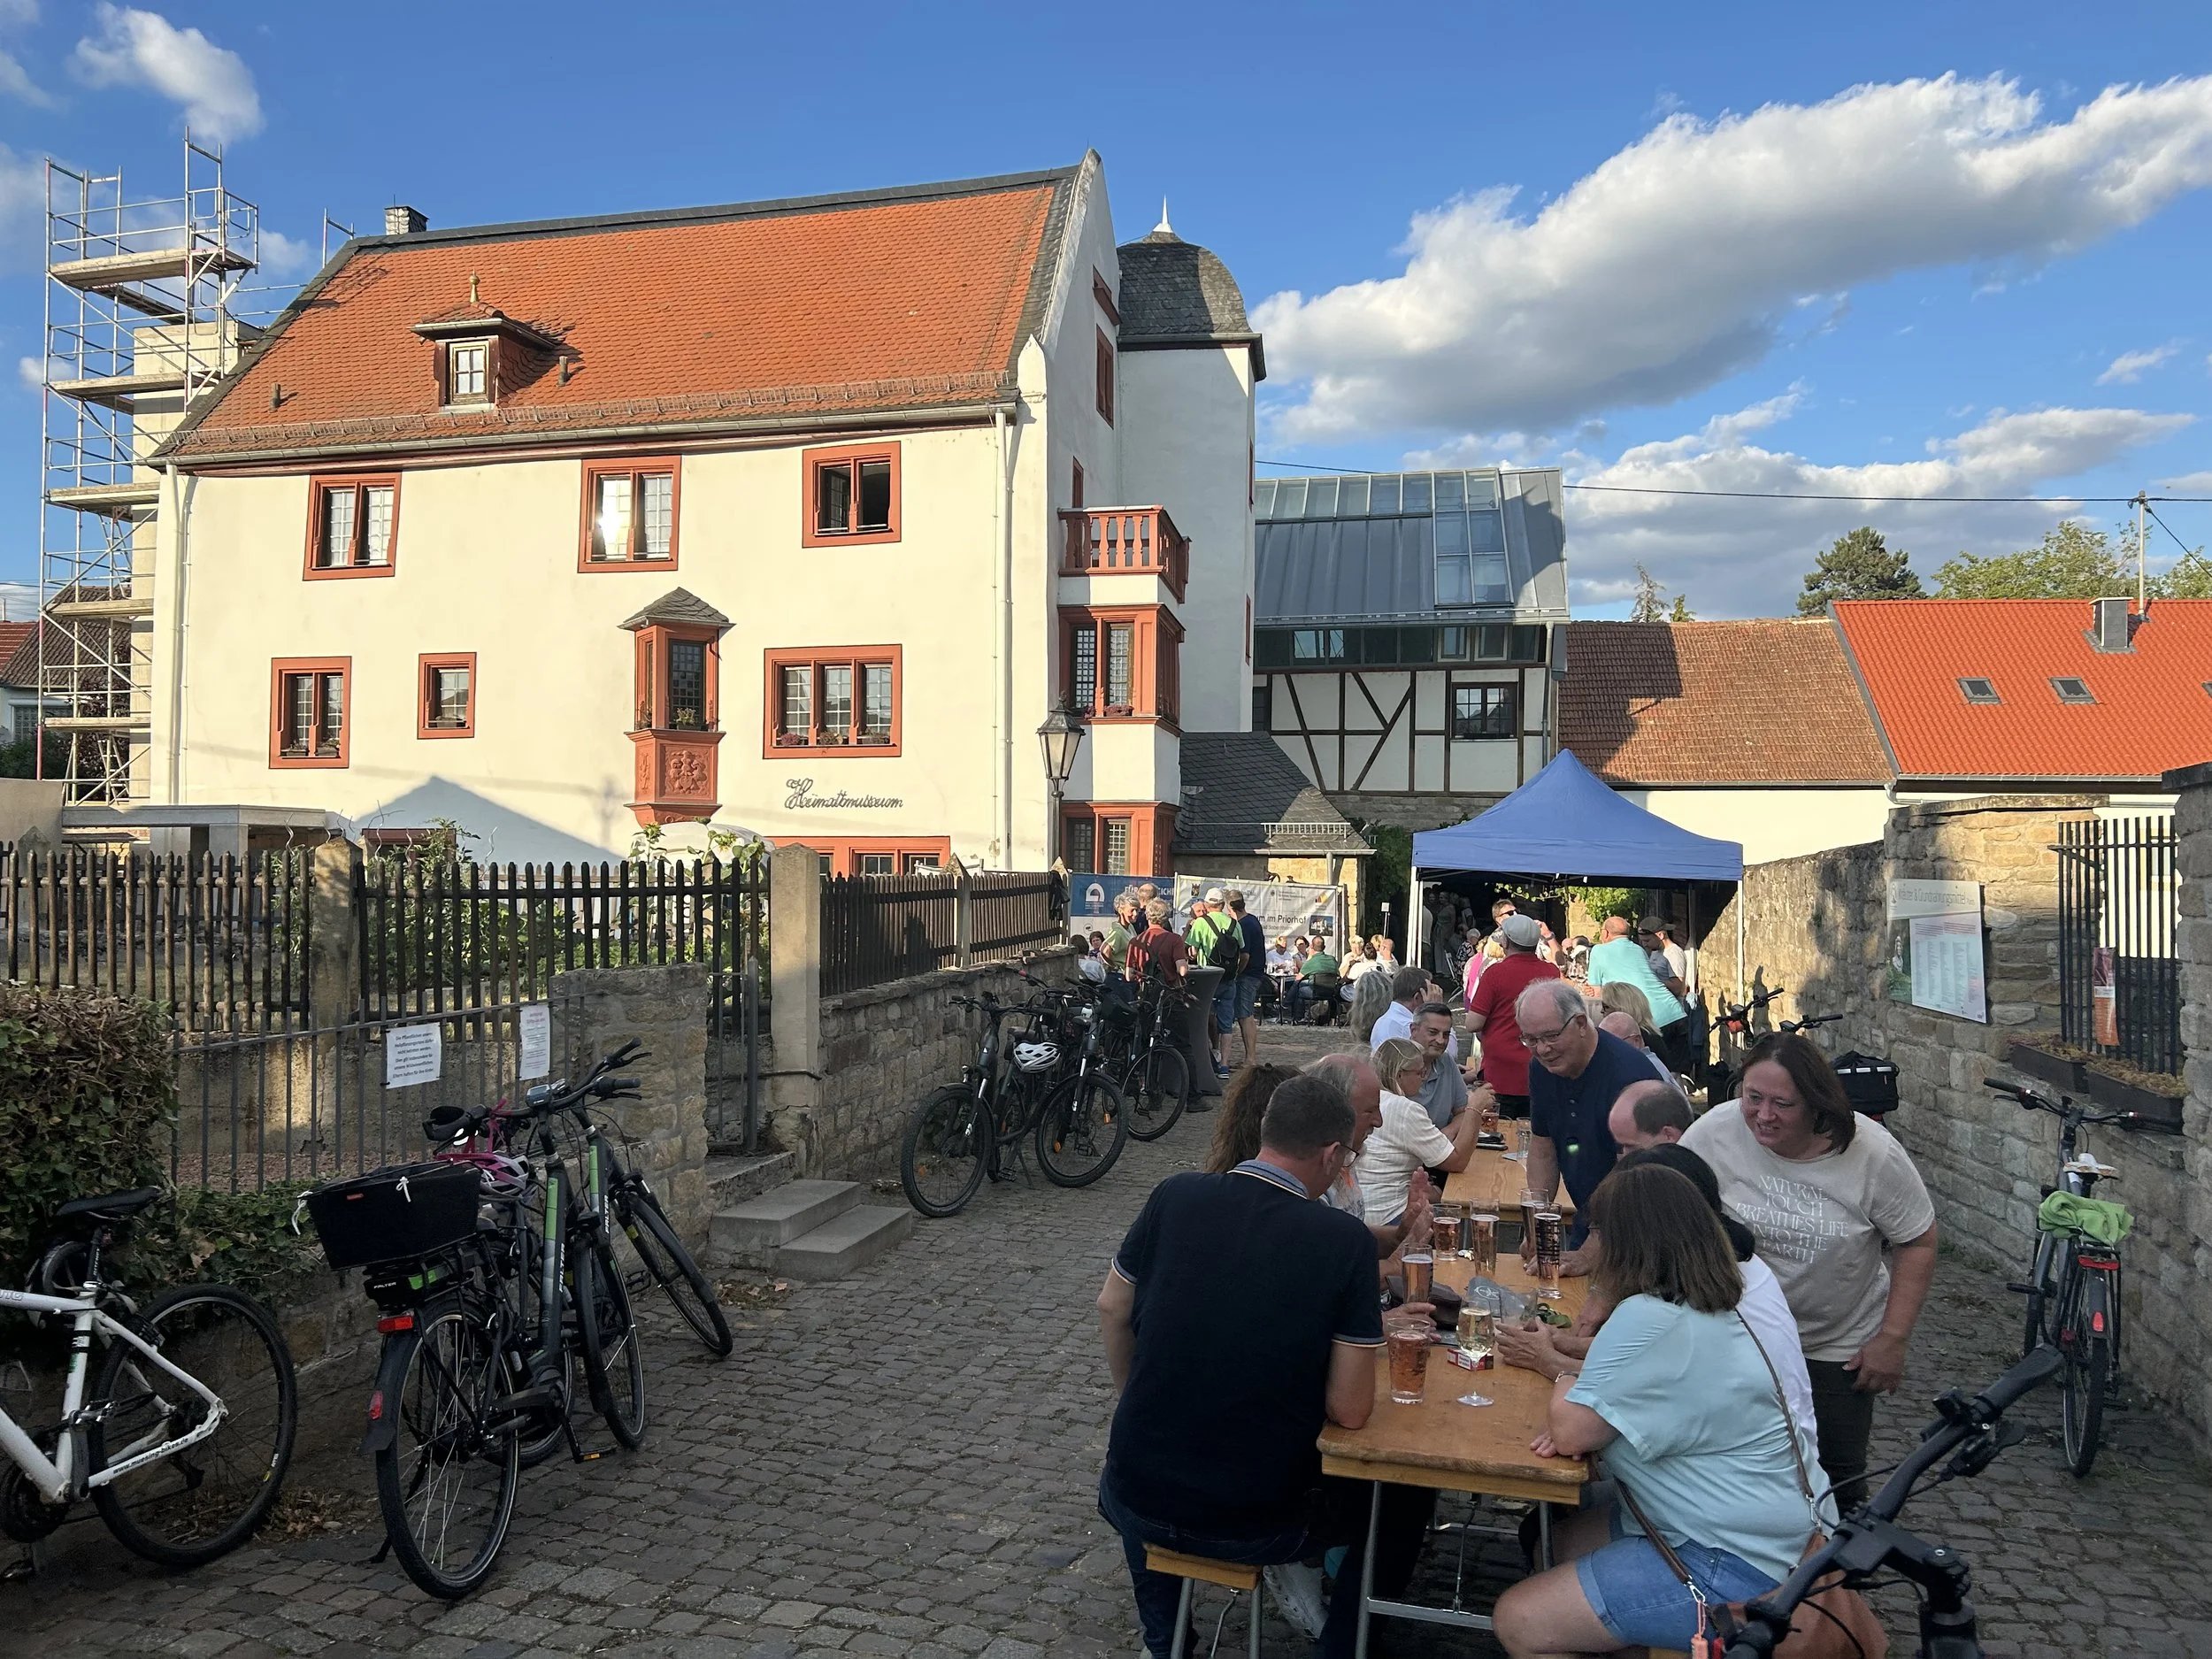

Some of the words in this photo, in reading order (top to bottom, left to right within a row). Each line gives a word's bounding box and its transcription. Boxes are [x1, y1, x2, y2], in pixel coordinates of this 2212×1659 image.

[784, 778, 903, 810] Heimatmuseum
[1278, 914, 1307, 925] Priorhof
[1759, 1174, 1829, 1201] NATURAL
[1765, 1193, 1823, 1217] TOUCH
[1736, 1202, 1815, 1234] BREATHES
[1819, 1219, 1849, 1238] LIFE
[1754, 1224, 1792, 1242] INTO
[1796, 1233, 1829, 1252] THE
[1762, 1240, 1816, 1264] EARTH
